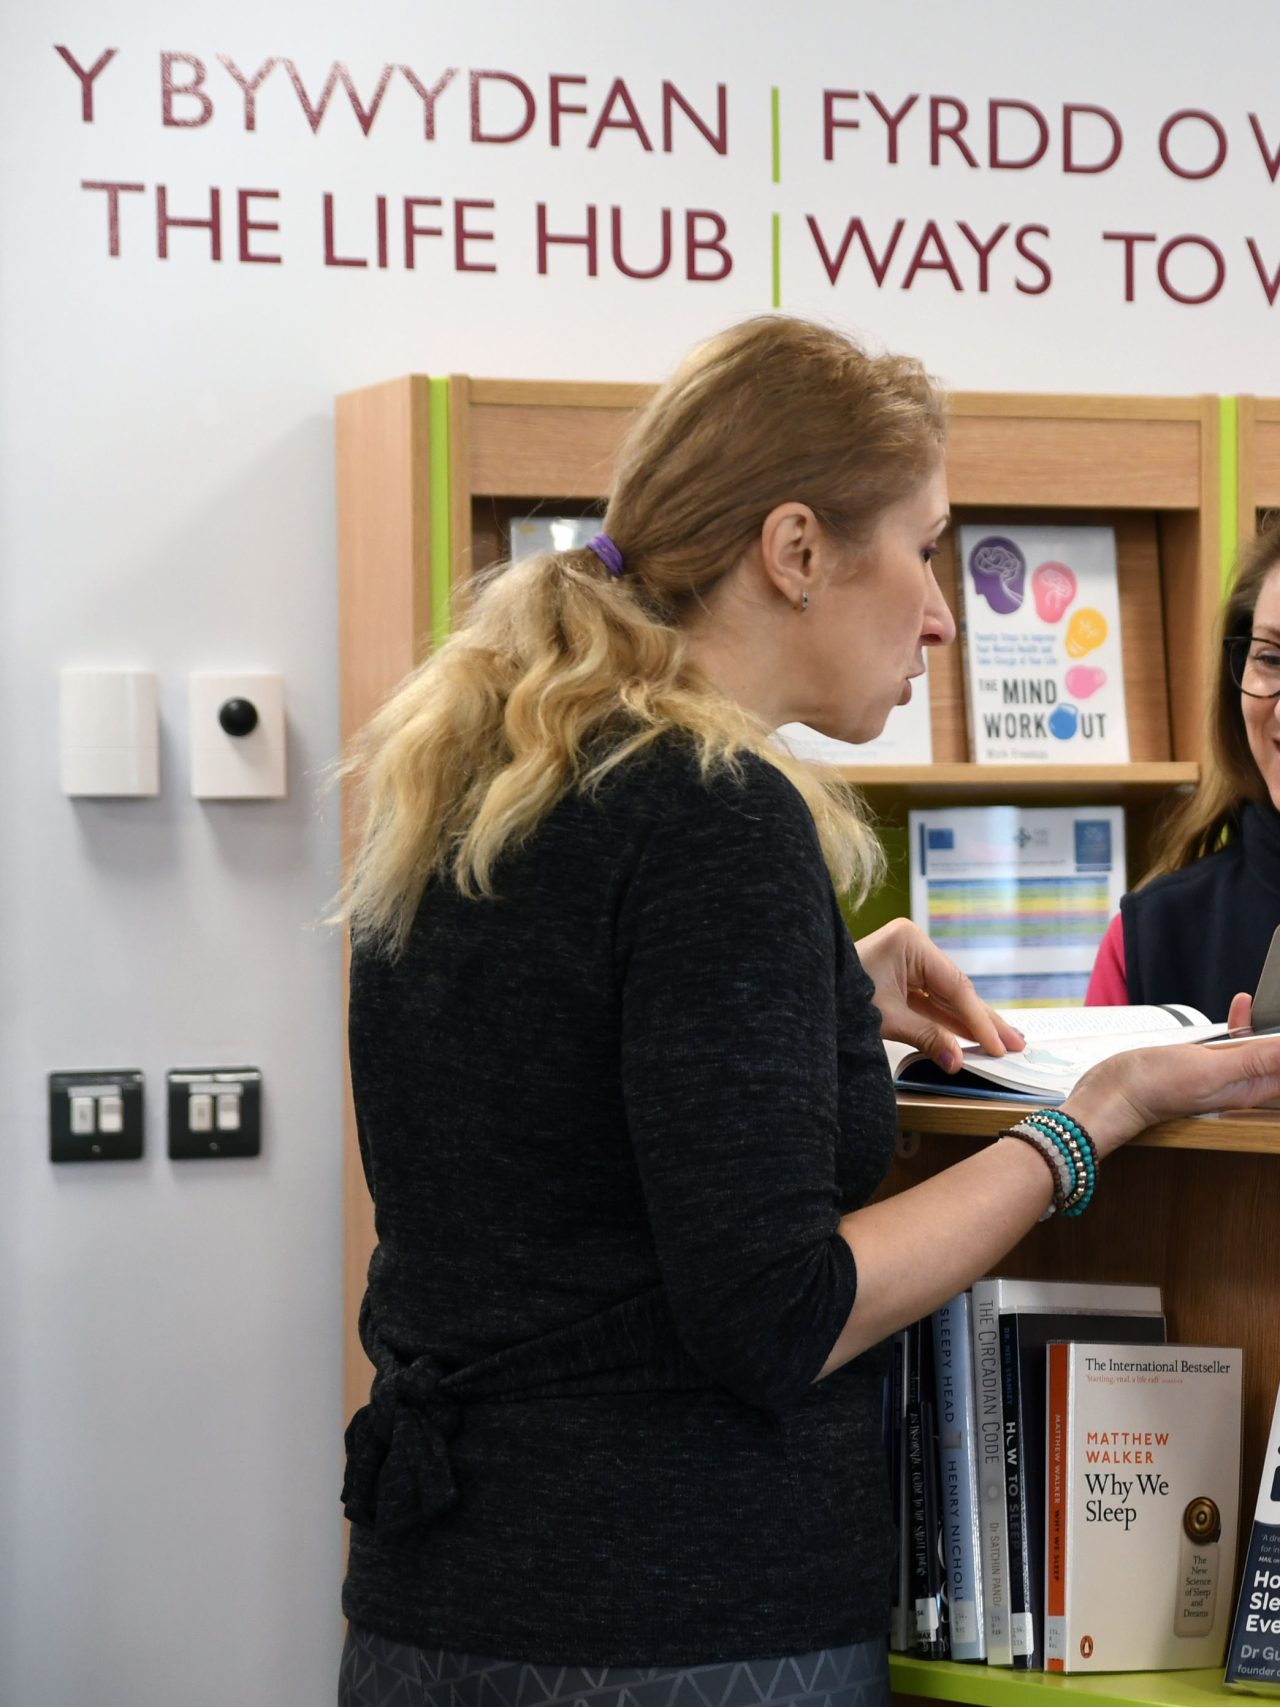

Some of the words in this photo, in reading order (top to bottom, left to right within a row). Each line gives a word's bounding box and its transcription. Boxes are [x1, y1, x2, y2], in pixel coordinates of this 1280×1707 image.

[54, 45, 119, 122] Y
[159, 51, 729, 156] BYWYDFAN
[821, 88, 1124, 174] FYRDD
[1158, 108, 1229, 182] O
[81, 179, 283, 266] THE
[321, 191, 497, 274] LIFE
[535, 202, 734, 282] HUB
[805, 213, 1053, 296] WAYS
[1103, 229, 1227, 305] TO
[1002, 679, 1057, 705] MIND
[978, 1300, 994, 1326] THE
[939, 1308, 953, 1369] SLEEPY
[978, 1330, 998, 1416] CIRCADIAN
[1085, 1358, 1106, 1371] The
[1109, 1358, 1178, 1373] International
[1180, 1360, 1231, 1374] Bestseller
[944, 1376, 954, 1424] HEAD
[981, 1421, 1000, 1465] CODE
[1054, 1414, 1062, 1462] MATTHEW
[1086, 1432, 1169, 1446] MATTHEW
[1086, 1451, 1154, 1464] WALKER
[947, 1460, 959, 1518] HENRY
[1008, 1475, 1019, 1497] TO
[1085, 1473, 1133, 1503] Why
[1136, 1474, 1169, 1495] We
[989, 1522, 999, 1533] Dr
[1009, 1503, 1022, 1552] SLEEP
[1086, 1500, 1137, 1530] Sleep
[990, 1534, 1001, 1573] SATCHIN
[1193, 1555, 1207, 1565] The
[1258, 1556, 1272, 1564] MAIL
[1260, 1545, 1271, 1554] for
[951, 1525, 964, 1602] NICHOLL
[1191, 1566, 1208, 1575] New
[1184, 1587, 1194, 1596] of
[1194, 1587, 1211, 1599] Sleep
[1186, 1577, 1211, 1586] Science
[1183, 1608, 1209, 1618] Dreams
[1191, 1598, 1203, 1607] and
[1240, 1645, 1259, 1659] Dr
[1237, 1665, 1275, 1677] founder
